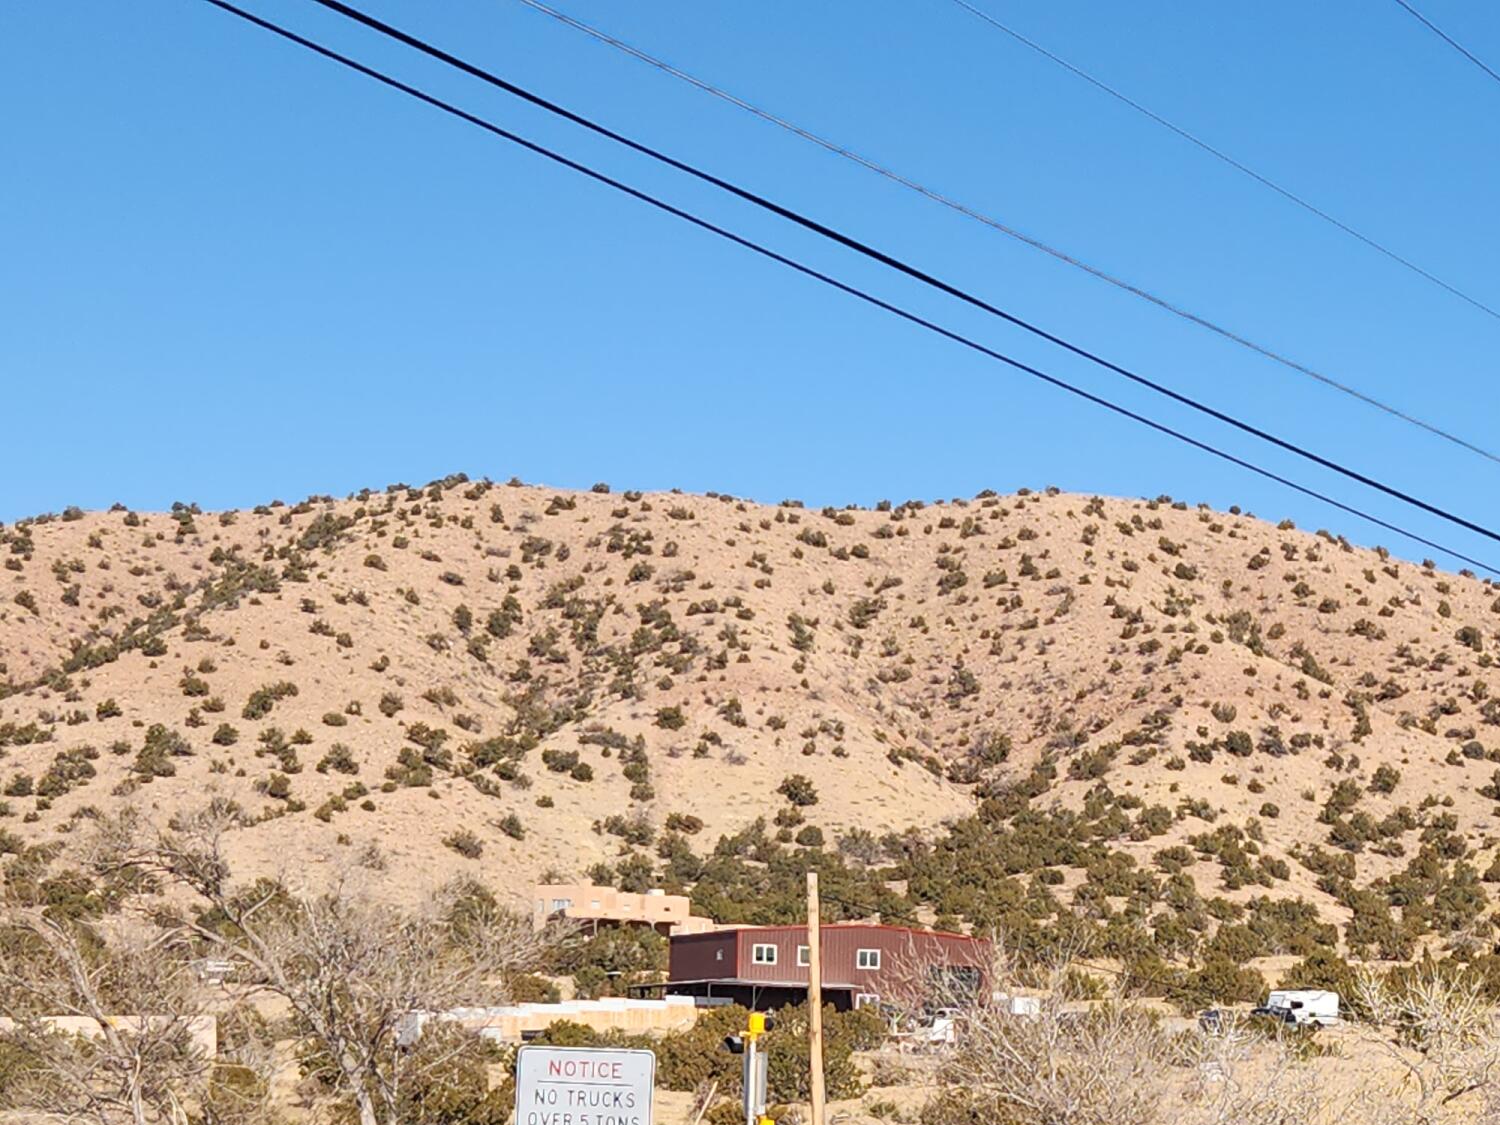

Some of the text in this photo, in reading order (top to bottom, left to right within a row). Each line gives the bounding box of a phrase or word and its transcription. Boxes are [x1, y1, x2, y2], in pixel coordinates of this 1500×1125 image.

[549, 1060, 623, 1080] NOTICE
[534, 1088, 636, 1108] NO TRUCKS
